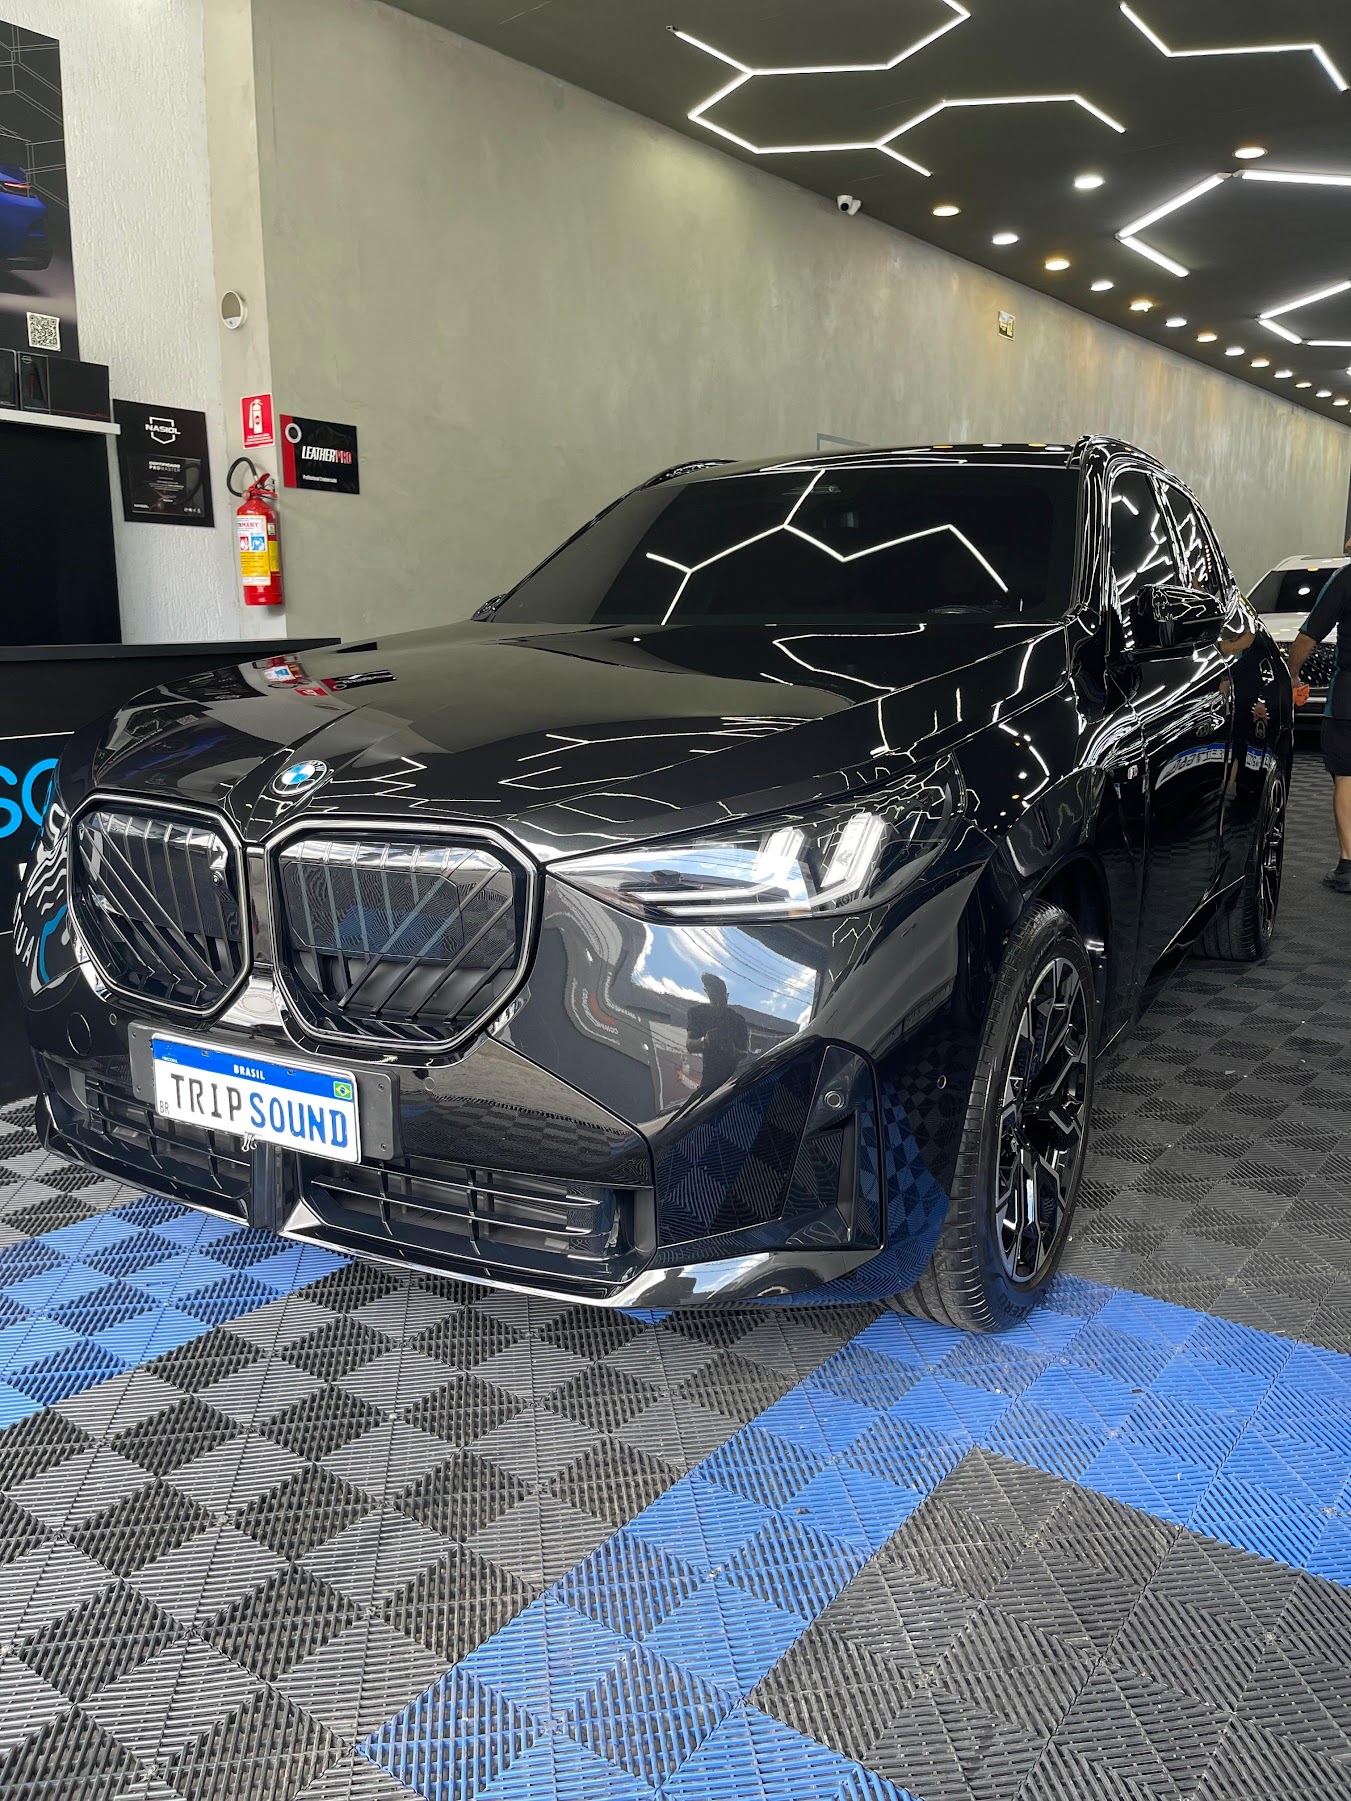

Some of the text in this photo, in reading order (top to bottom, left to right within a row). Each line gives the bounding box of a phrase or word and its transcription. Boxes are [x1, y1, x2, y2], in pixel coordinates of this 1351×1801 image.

[145, 423, 181, 435] NASIOL
[233, 1064, 266, 1080] BRASIL
[159, 1100, 170, 1115] BR
[170, 1073, 349, 1148] TRIP SOUND
